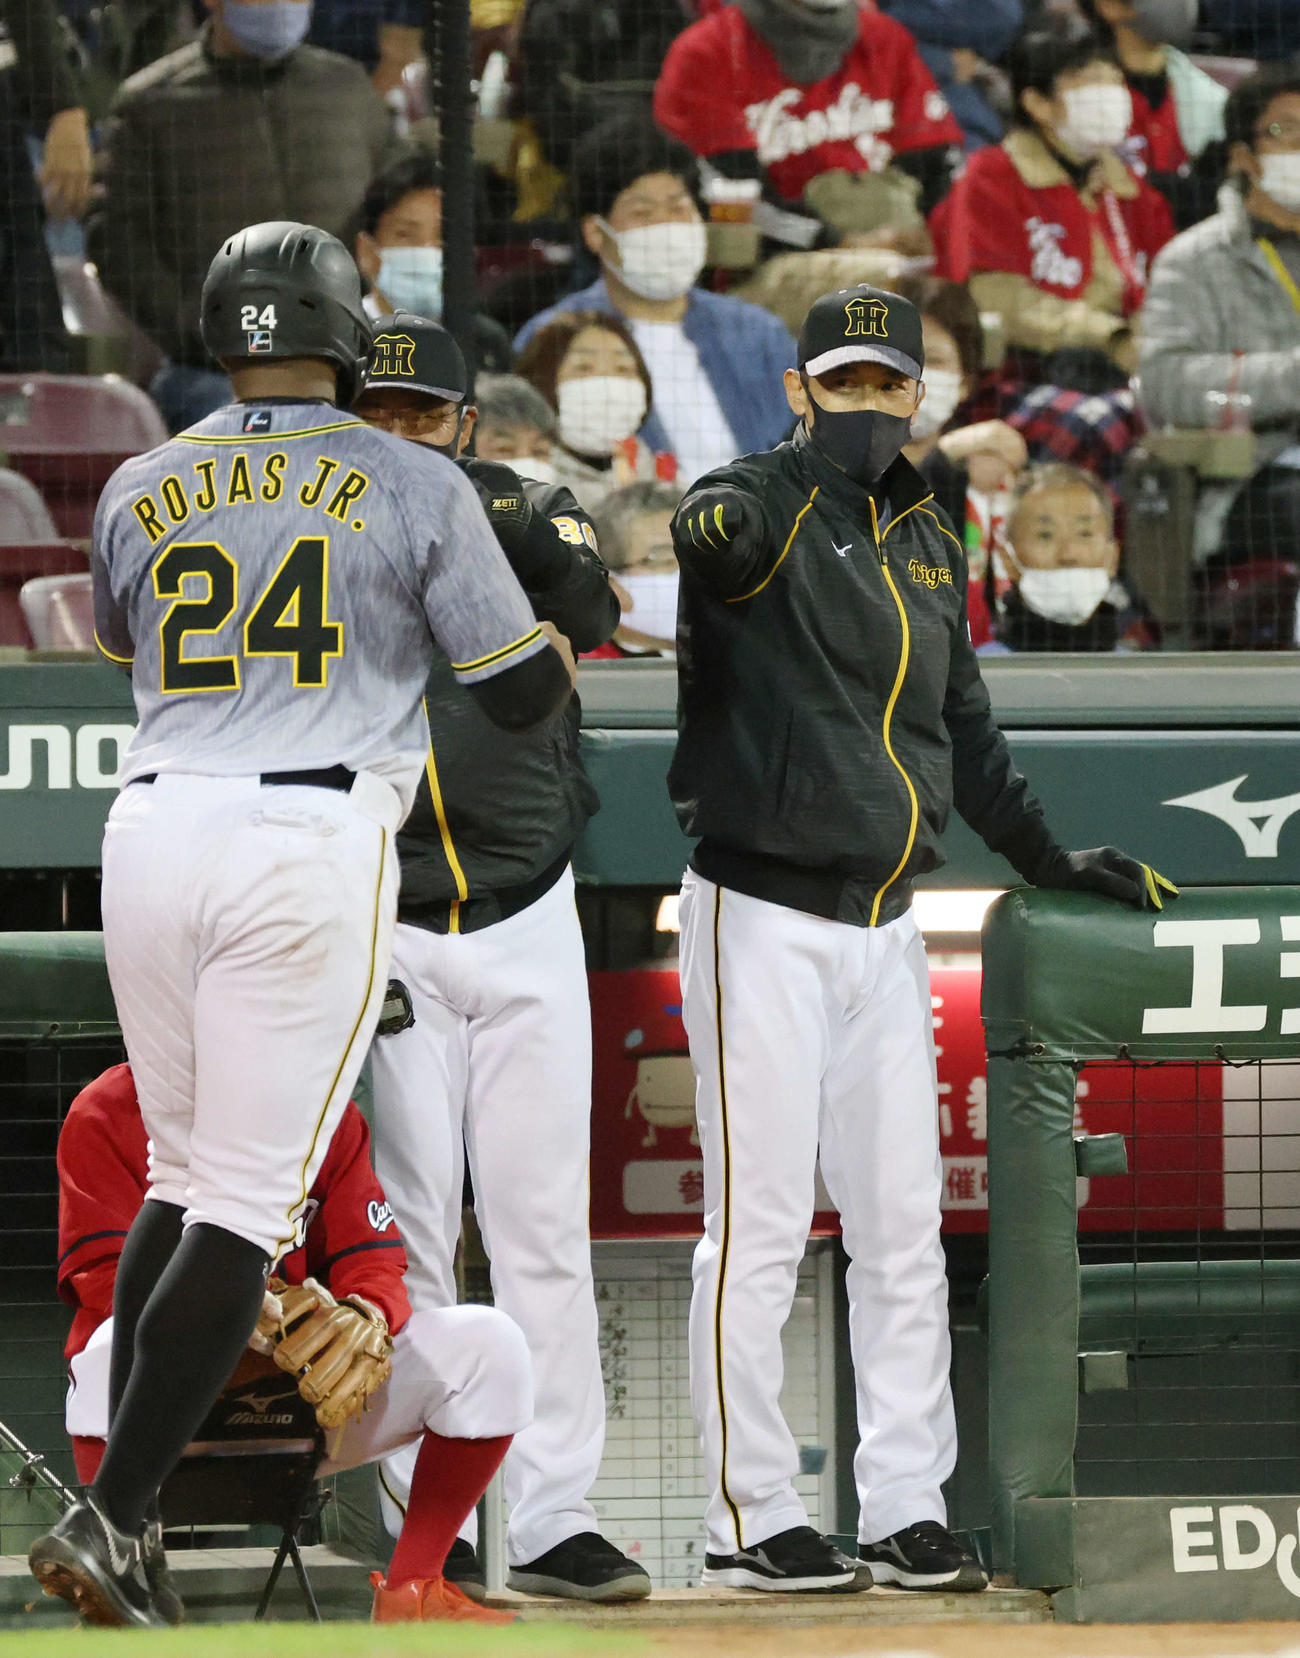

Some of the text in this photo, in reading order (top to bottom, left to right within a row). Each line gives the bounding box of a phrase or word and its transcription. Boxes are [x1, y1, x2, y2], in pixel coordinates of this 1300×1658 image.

[240, 304, 278, 330] 24
[132, 452, 370, 545] ROJAS JR.
[152, 536, 344, 694] 24
[1141, 916, 1300, 1035] エ
